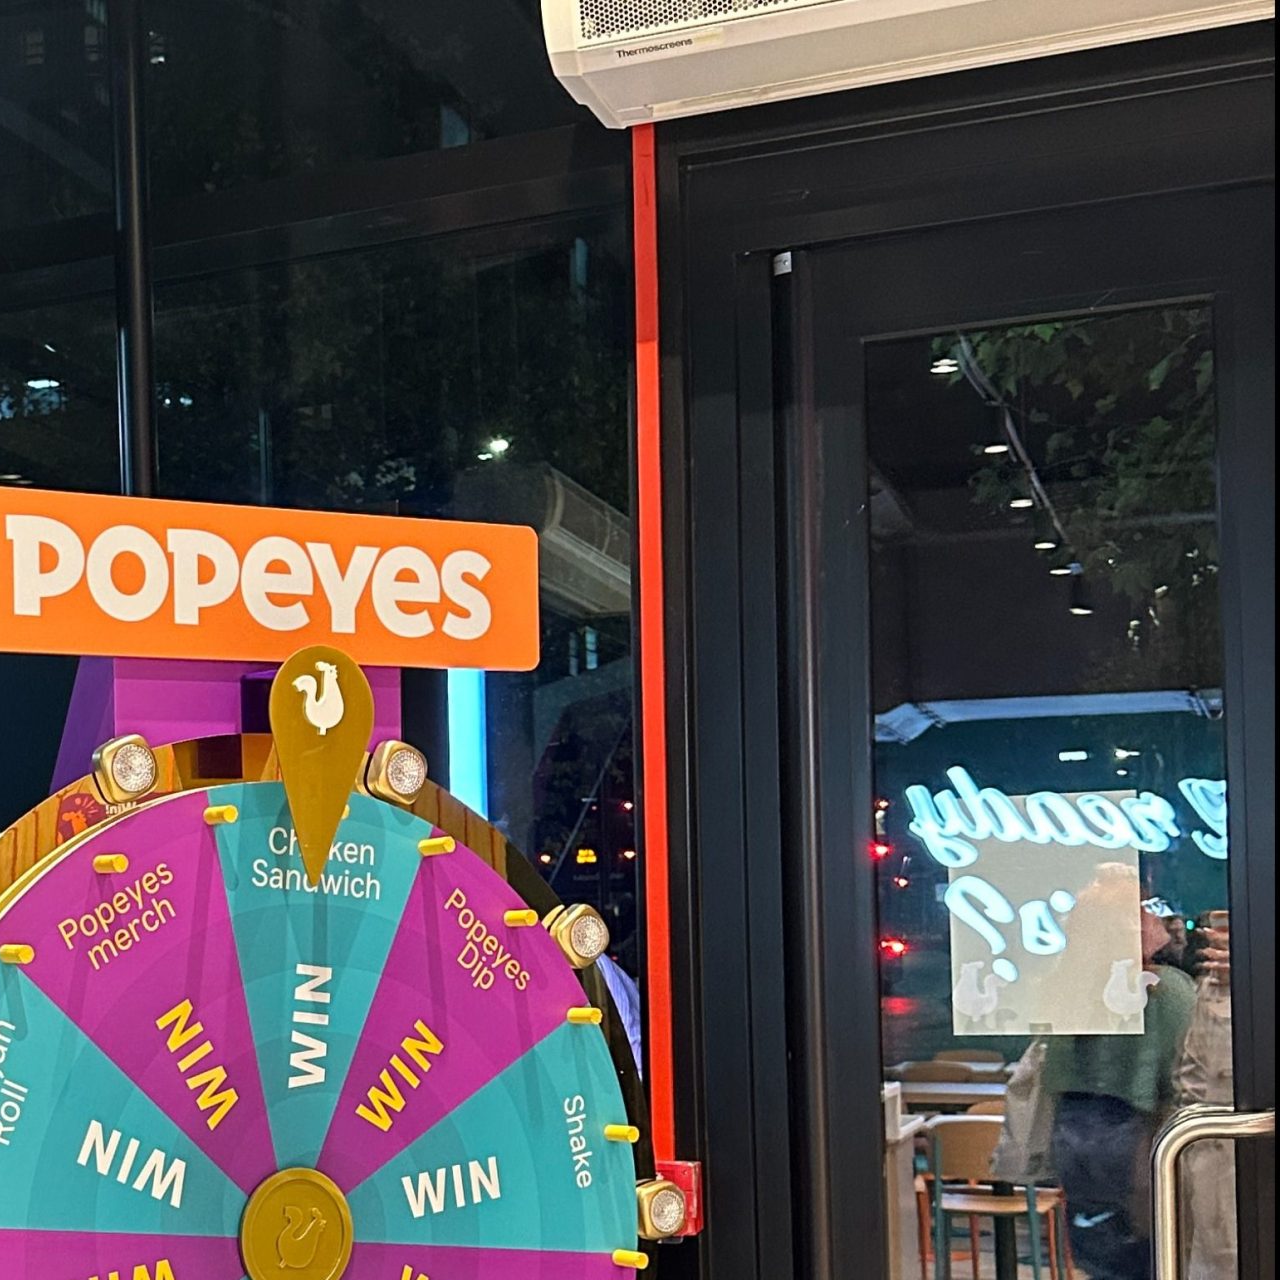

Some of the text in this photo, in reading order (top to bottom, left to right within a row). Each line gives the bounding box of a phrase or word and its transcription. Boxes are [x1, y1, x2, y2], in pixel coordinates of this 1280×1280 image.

[616, 38, 693, 58] Thermoscreens
[268, 826, 375, 866] Chken
[58, 862, 174, 949] Popeyes
[87, 898, 177, 970] merch
[444, 888, 532, 991] Popeyes
[456, 941, 495, 991] Dip
[155, 999, 240, 1131] WIN
[288, 963, 333, 1089] WIN
[354, 1018, 445, 1132] WIN
[76, 1119, 187, 1209] WIN
[563, 1094, 593, 1189] Shake
[401, 1156, 501, 1219] WIN
